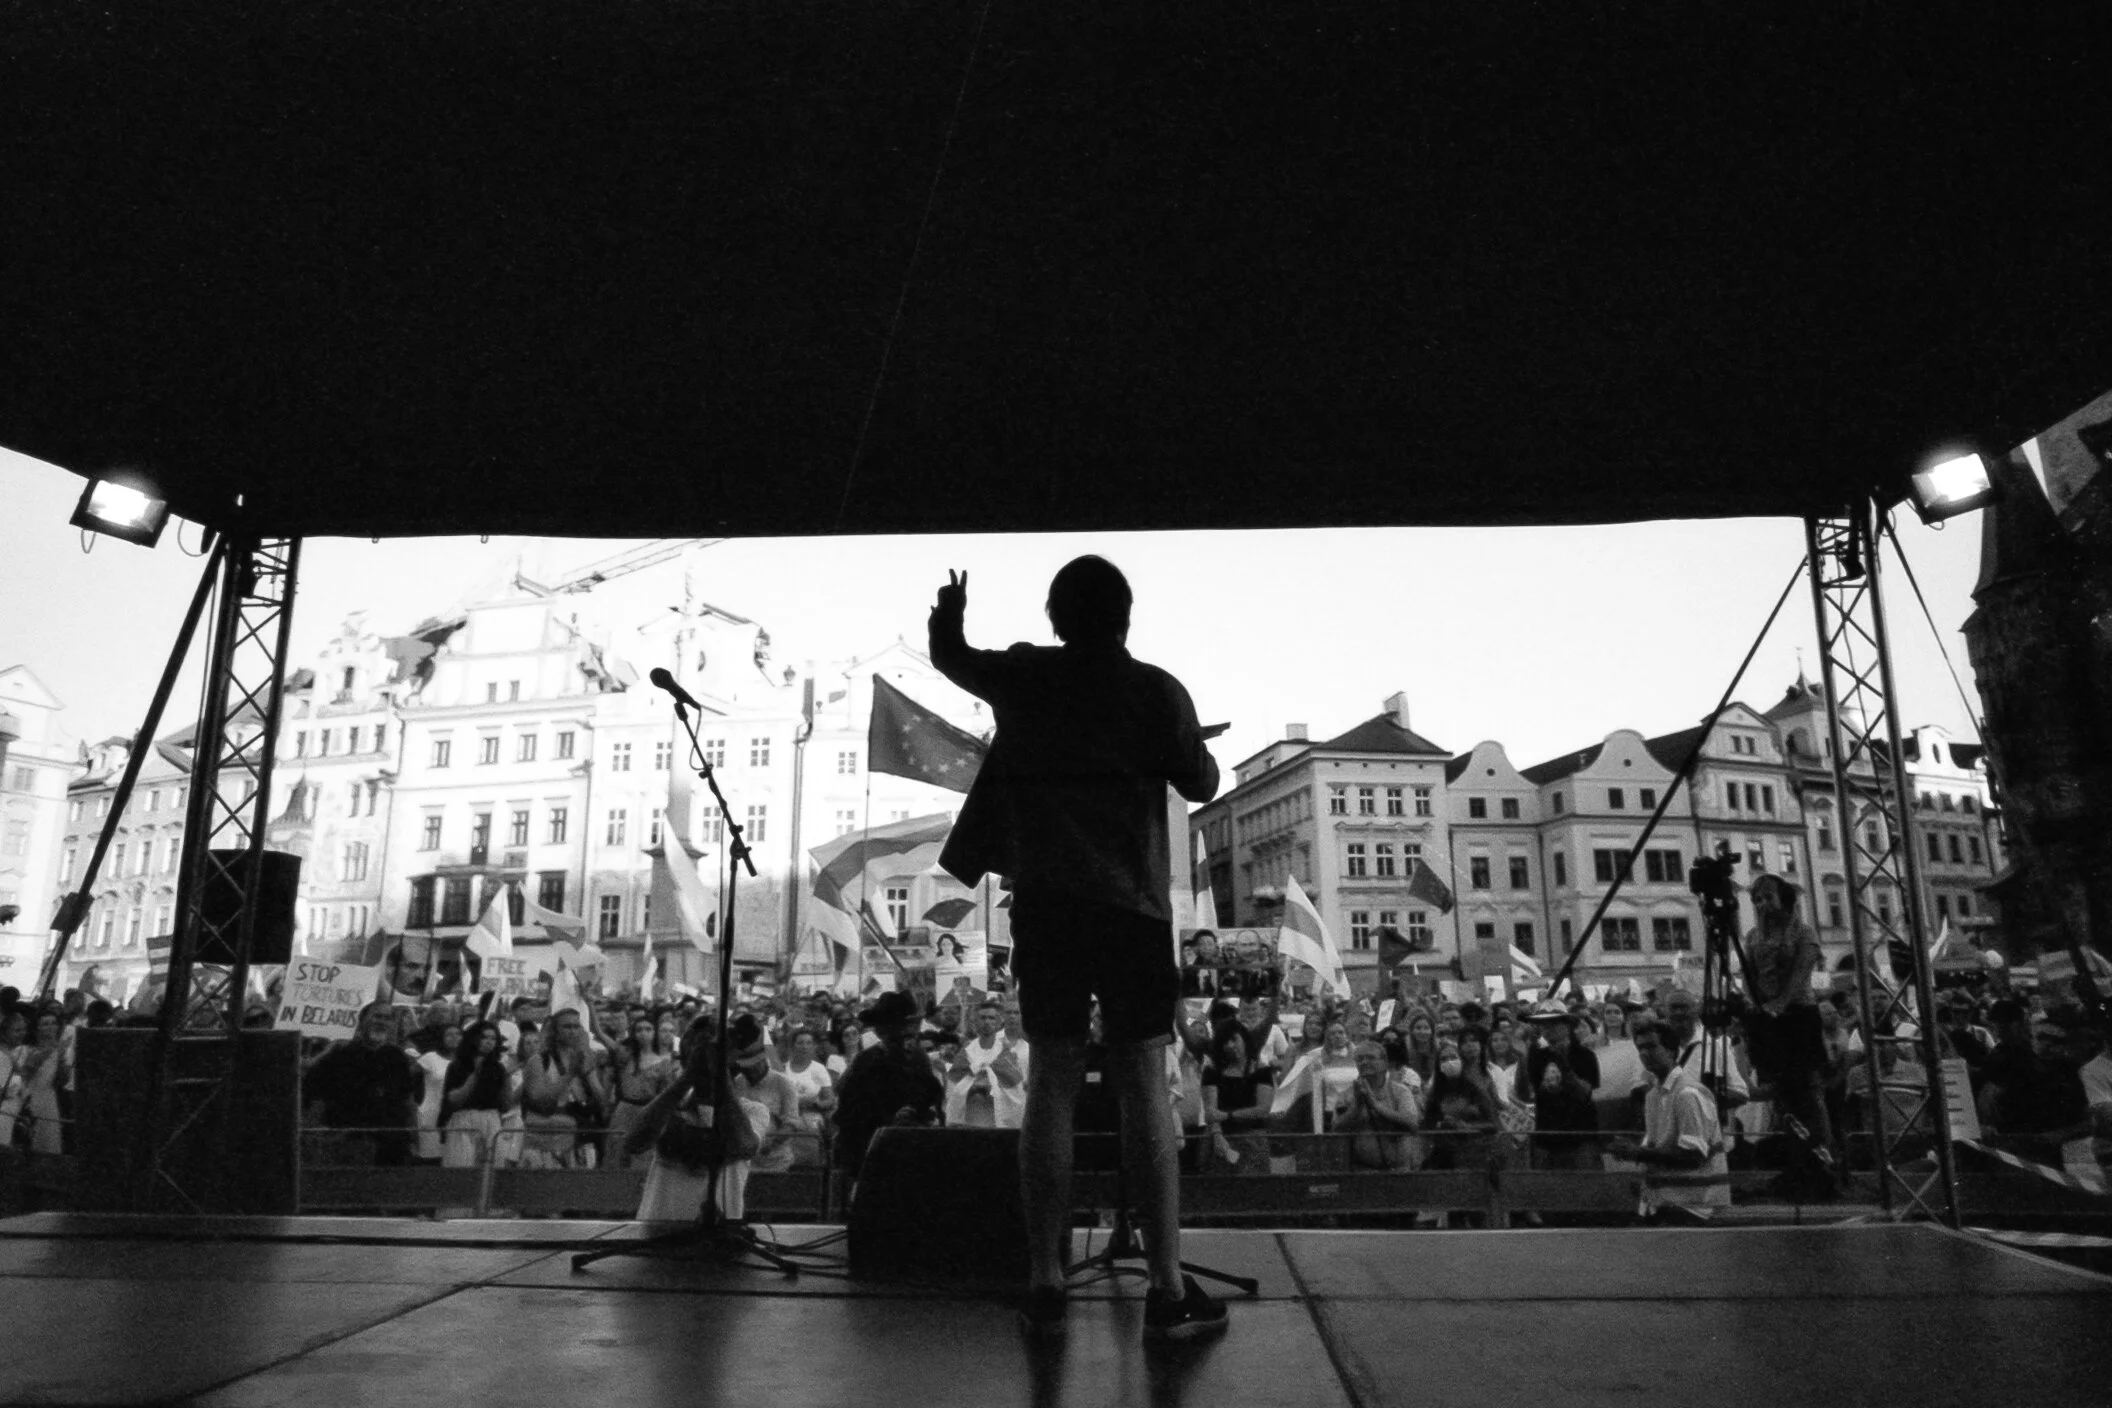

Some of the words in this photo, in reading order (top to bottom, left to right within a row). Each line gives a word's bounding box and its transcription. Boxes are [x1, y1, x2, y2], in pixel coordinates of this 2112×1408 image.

[295, 963, 340, 983] STOP
[486, 957, 527, 975] FREE
[280, 1005, 297, 1022] IN
[301, 1005, 359, 1028] BELARUS
